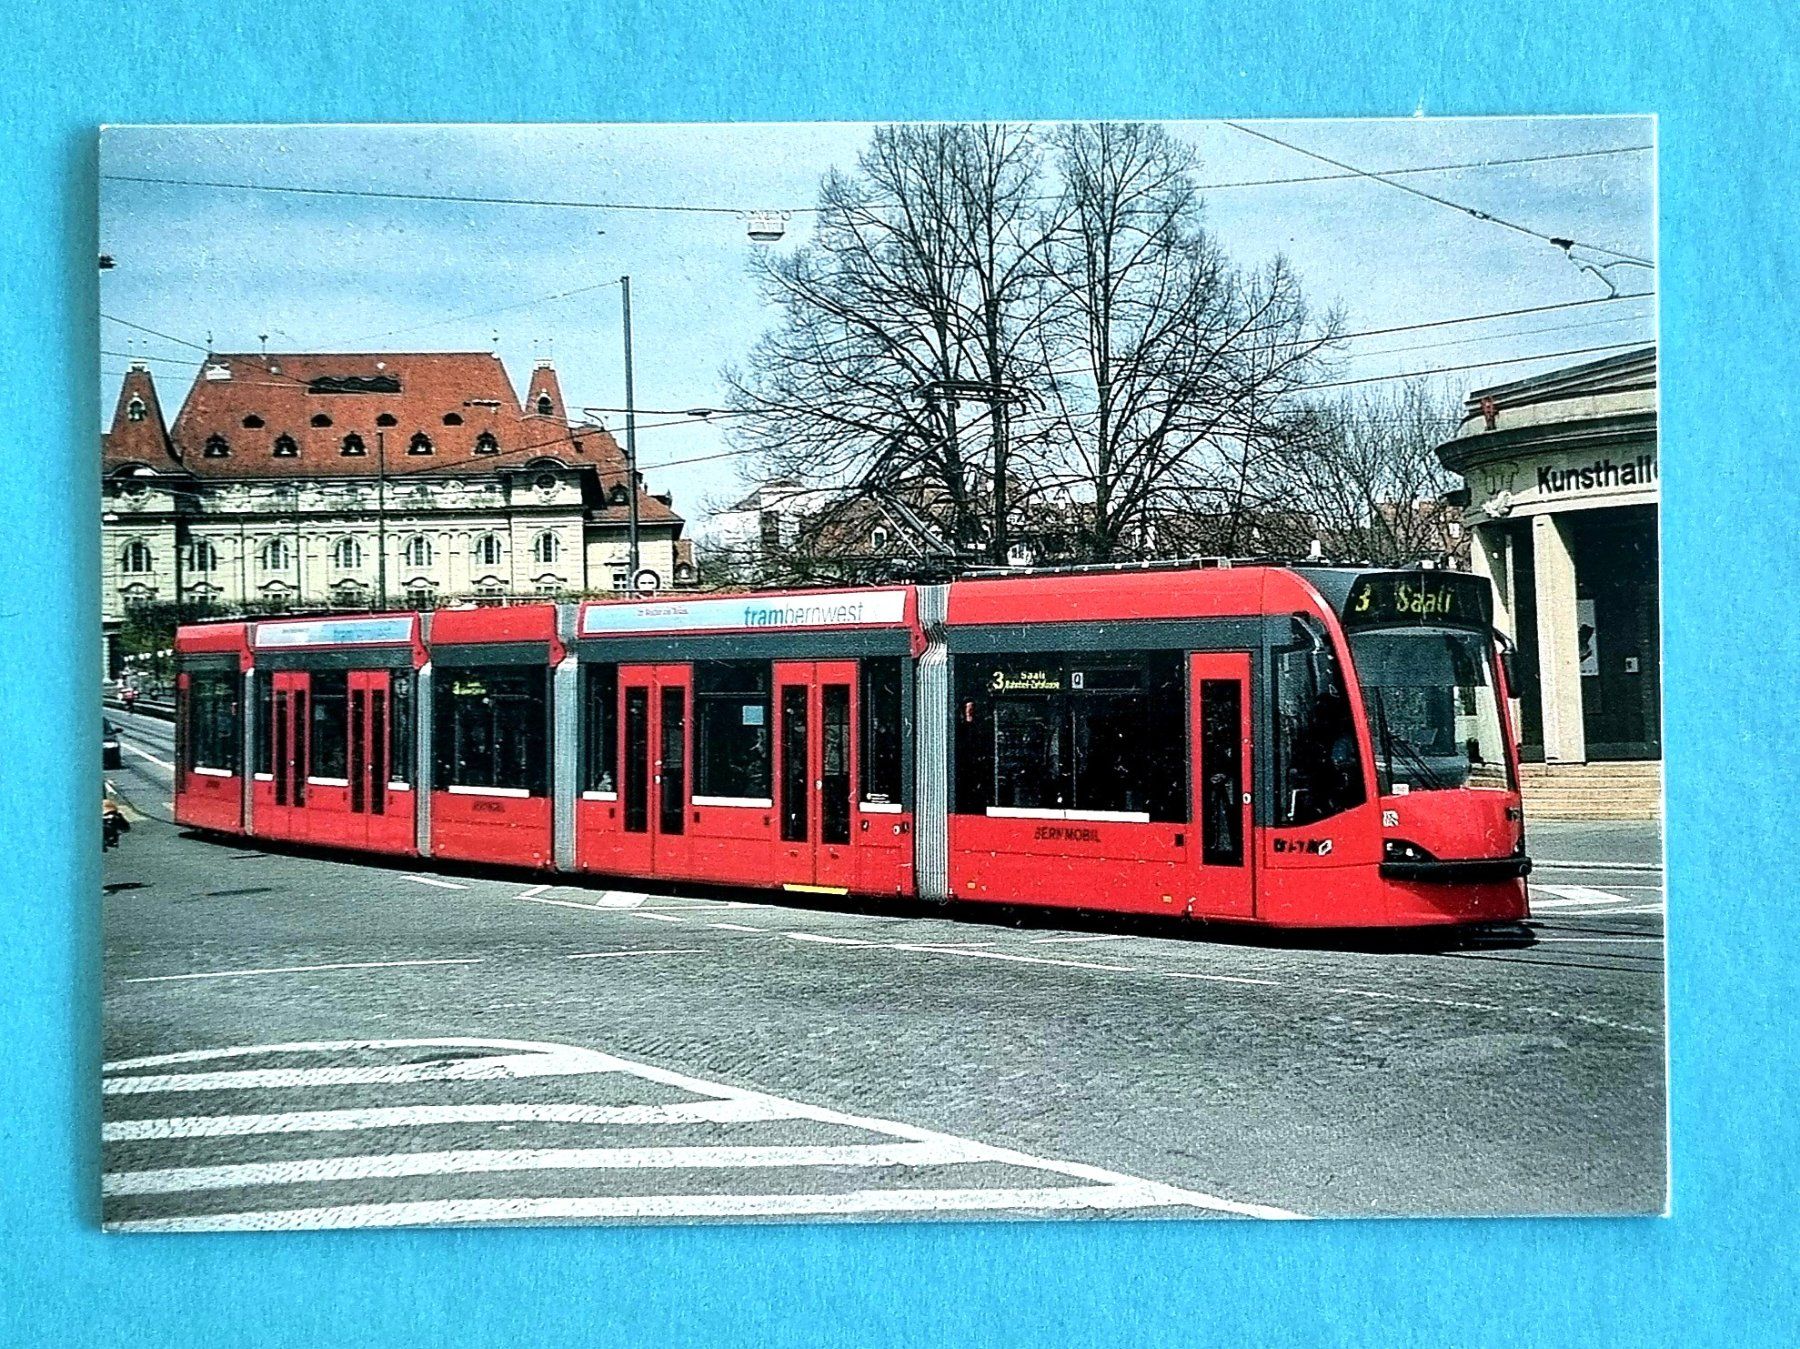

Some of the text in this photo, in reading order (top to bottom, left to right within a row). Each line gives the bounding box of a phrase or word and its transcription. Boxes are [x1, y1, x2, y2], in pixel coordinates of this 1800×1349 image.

[1355, 581, 1452, 613] 3 Saali
[744, 602, 864, 627] trambernwest
[992, 671, 1004, 690] 3
